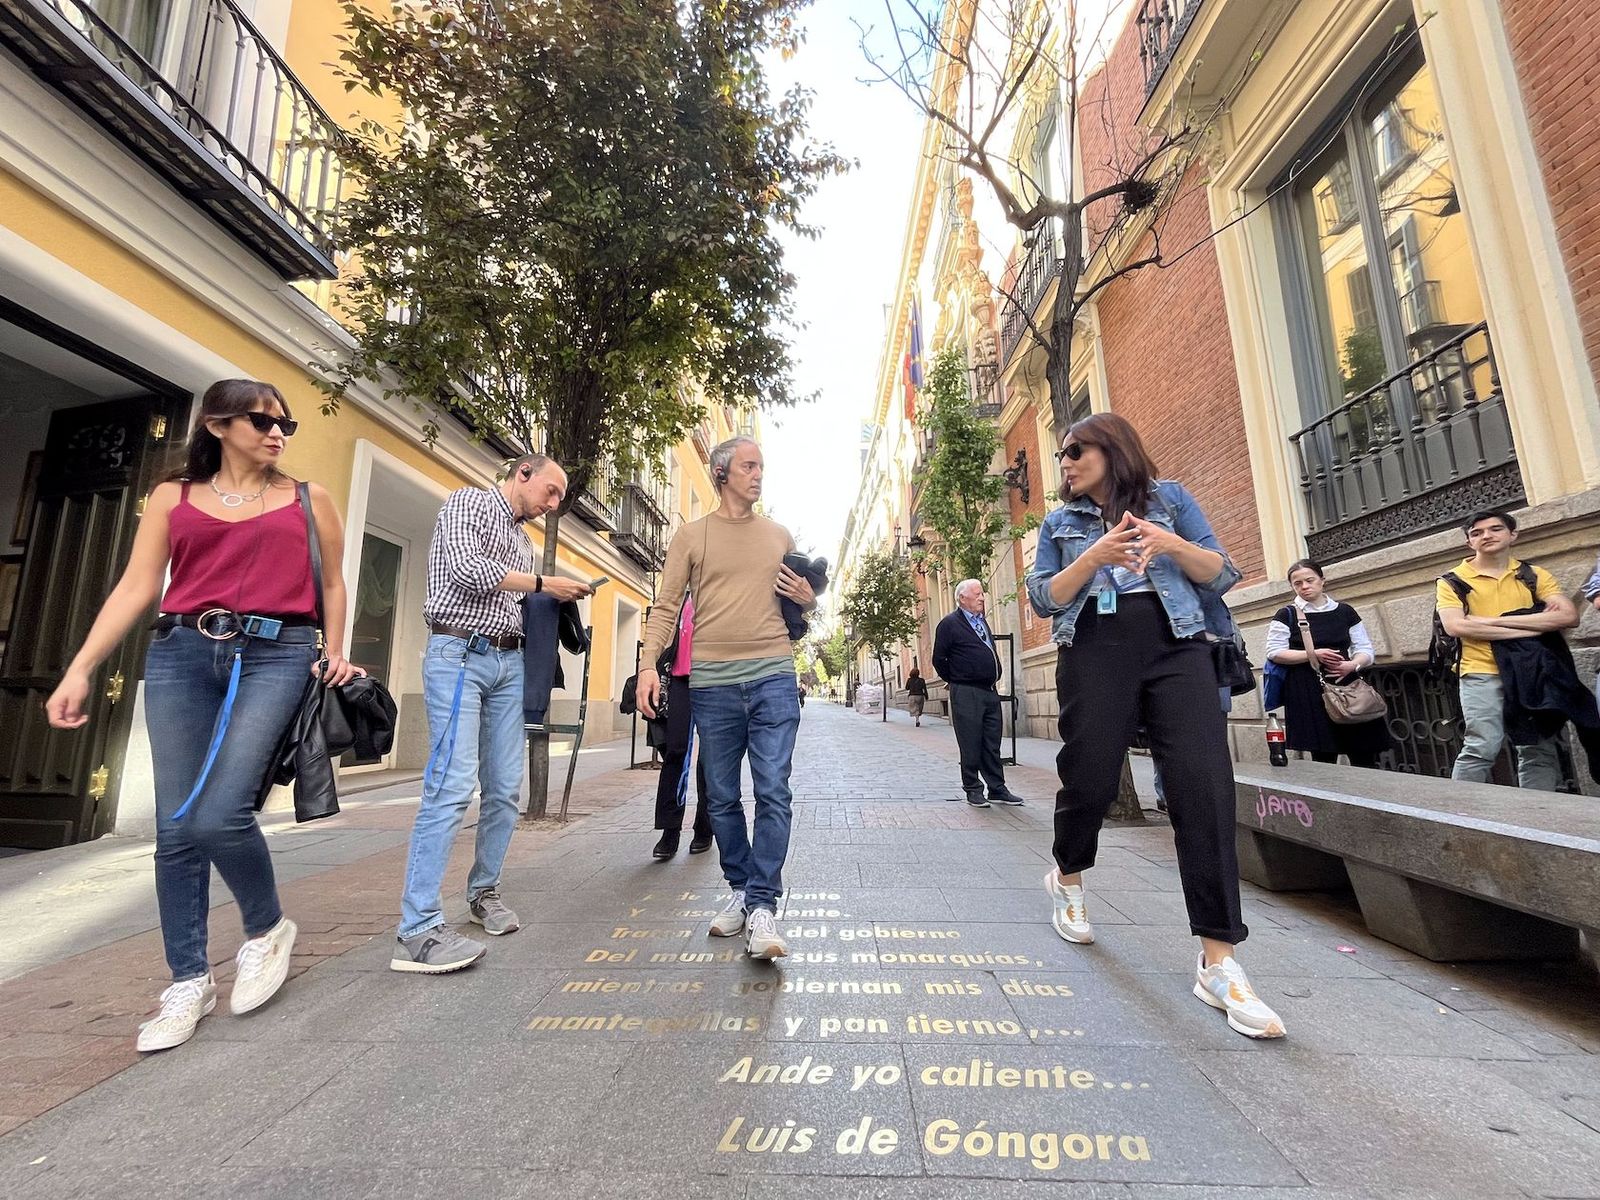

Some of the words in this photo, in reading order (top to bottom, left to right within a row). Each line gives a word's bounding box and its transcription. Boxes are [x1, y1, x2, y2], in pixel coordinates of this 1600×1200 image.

[786, 926, 827, 939] del
[839, 926, 961, 941] gobierno
[584, 949, 640, 963] Del
[791, 951, 838, 964] sus
[924, 978, 983, 996] mis
[1001, 978, 1075, 998] días
[784, 1017, 806, 1038] y
[819, 1015, 889, 1038] pan
[717, 1056, 834, 1086] Ande
[849, 1063, 902, 1091] yo
[715, 1117, 818, 1155] Luis
[835, 1116, 900, 1155] de
[922, 1118, 1152, 1171] Góngora
